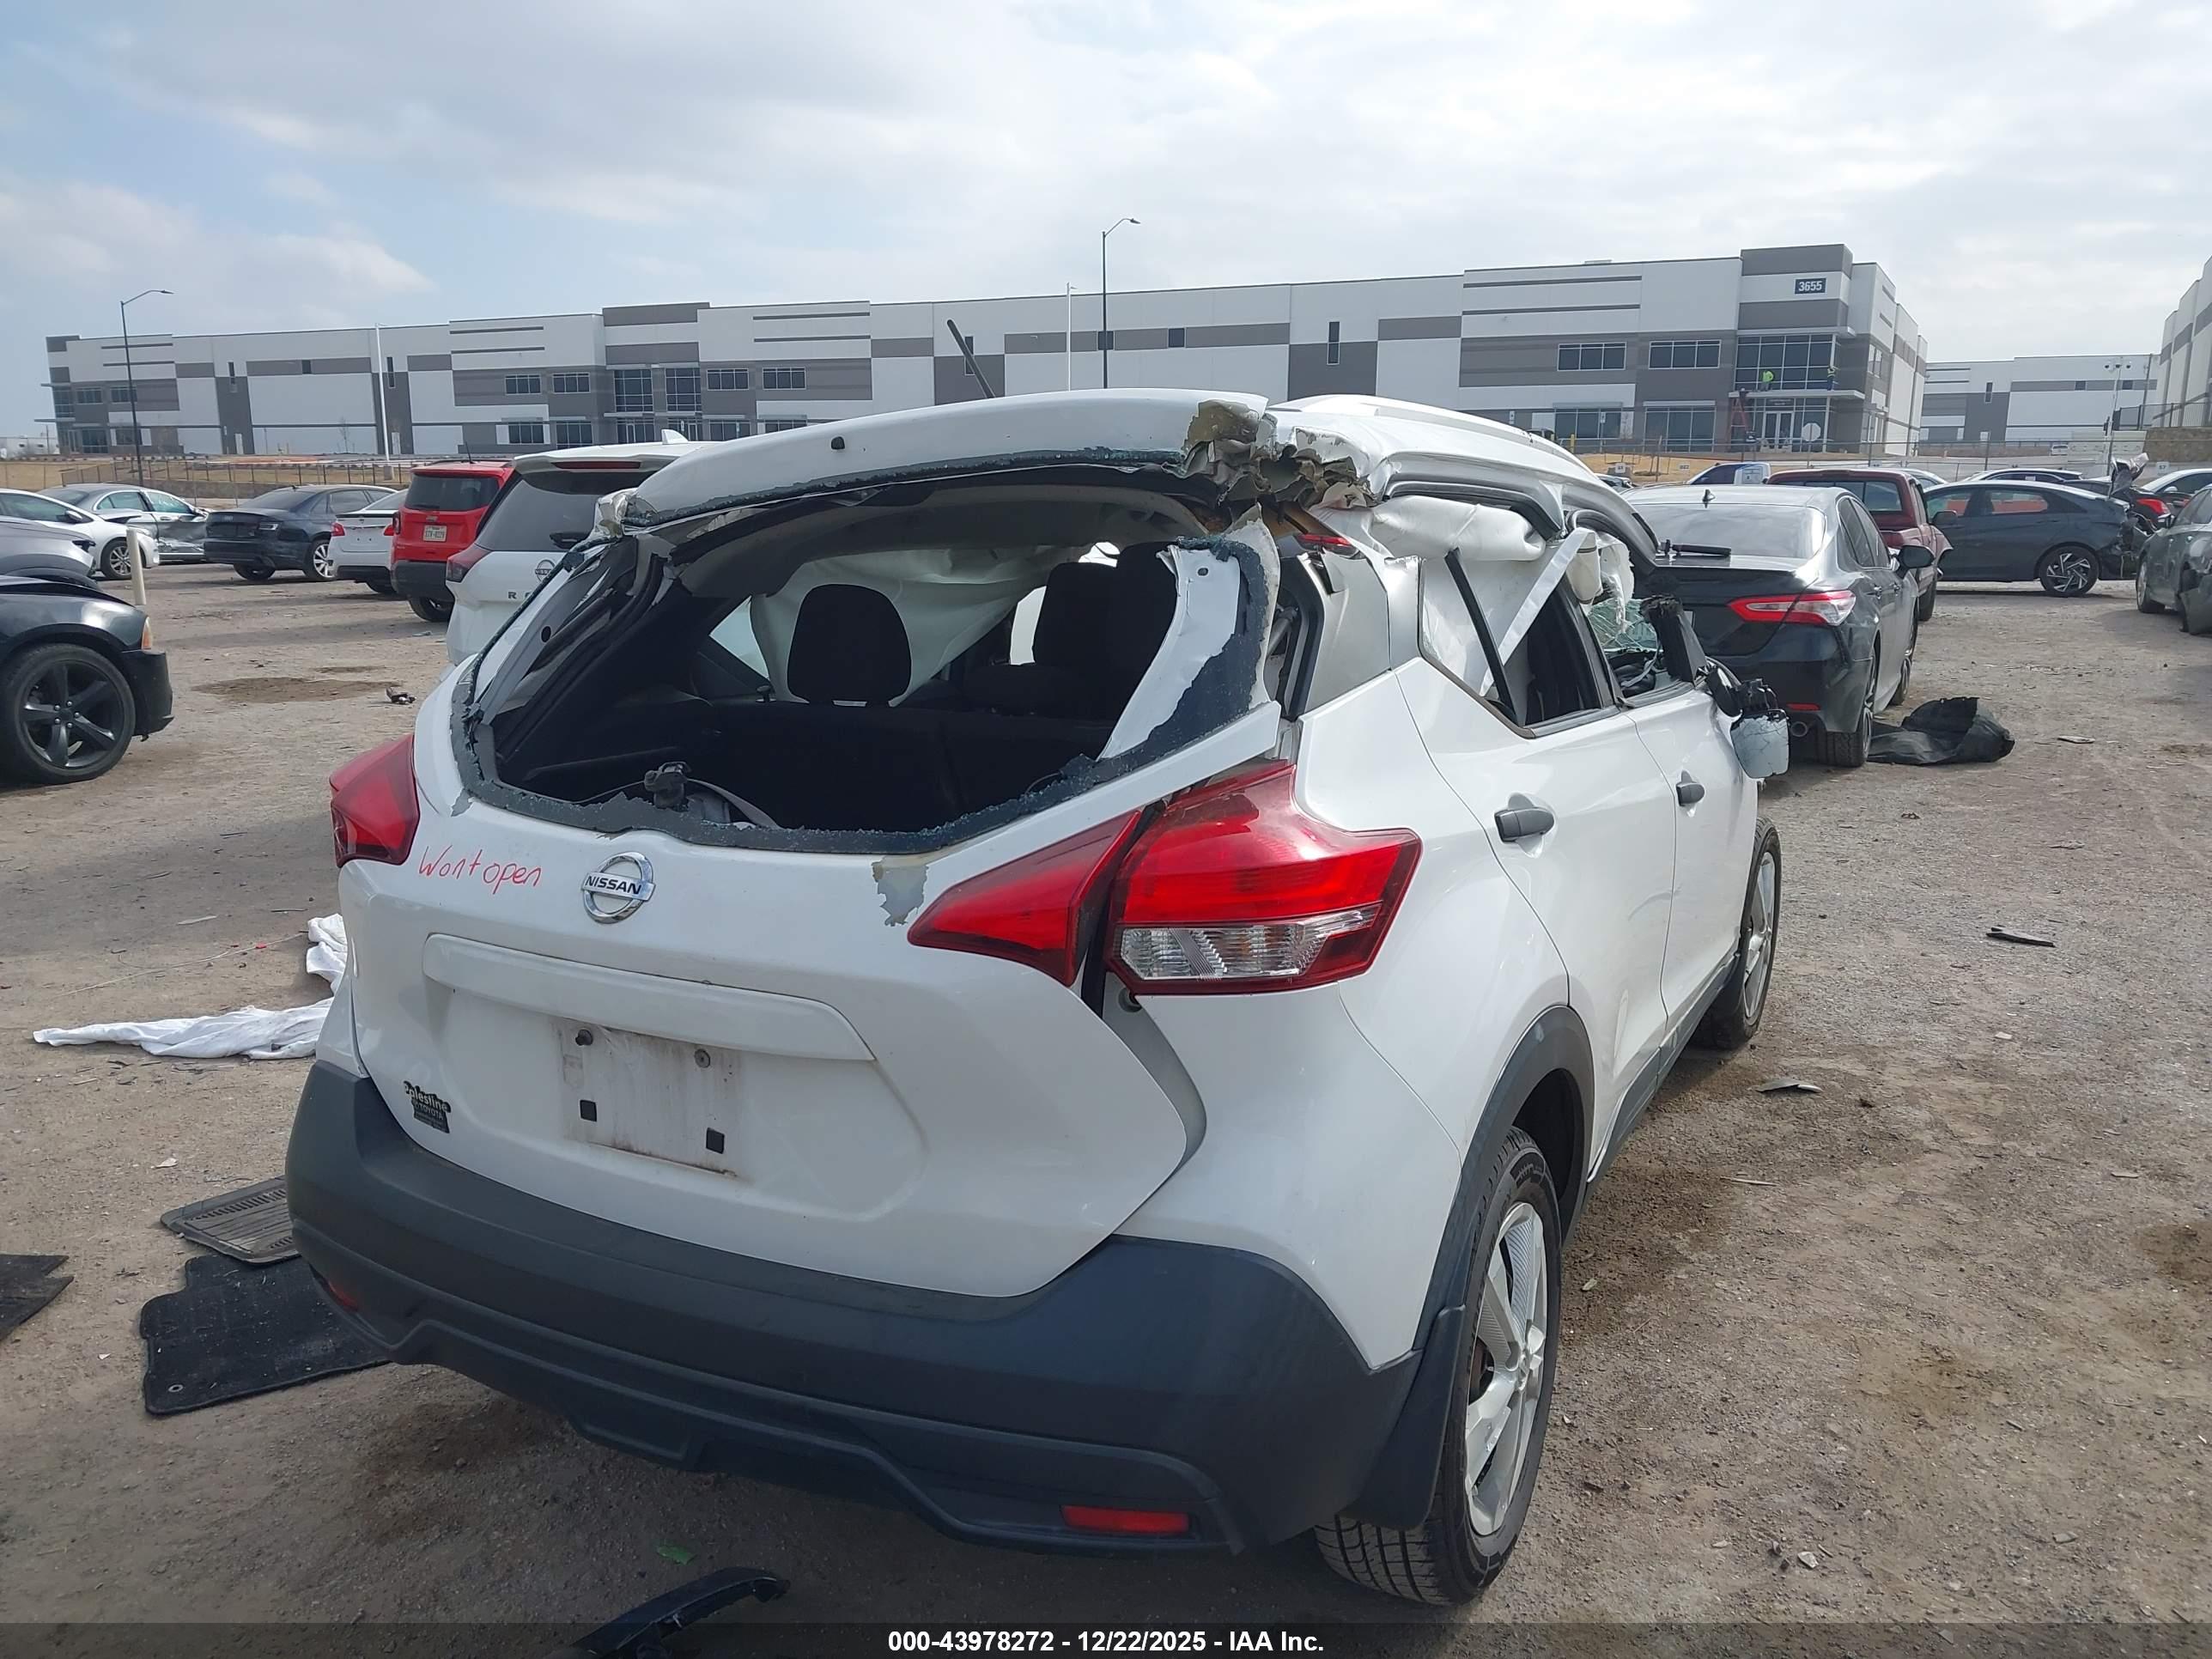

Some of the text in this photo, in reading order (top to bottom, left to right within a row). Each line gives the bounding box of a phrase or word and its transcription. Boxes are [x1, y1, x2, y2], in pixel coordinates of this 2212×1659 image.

[1798, 281, 1822, 292] 3655
[418, 845, 542, 896] Wont open
[584, 874, 642, 896] NISSAN
